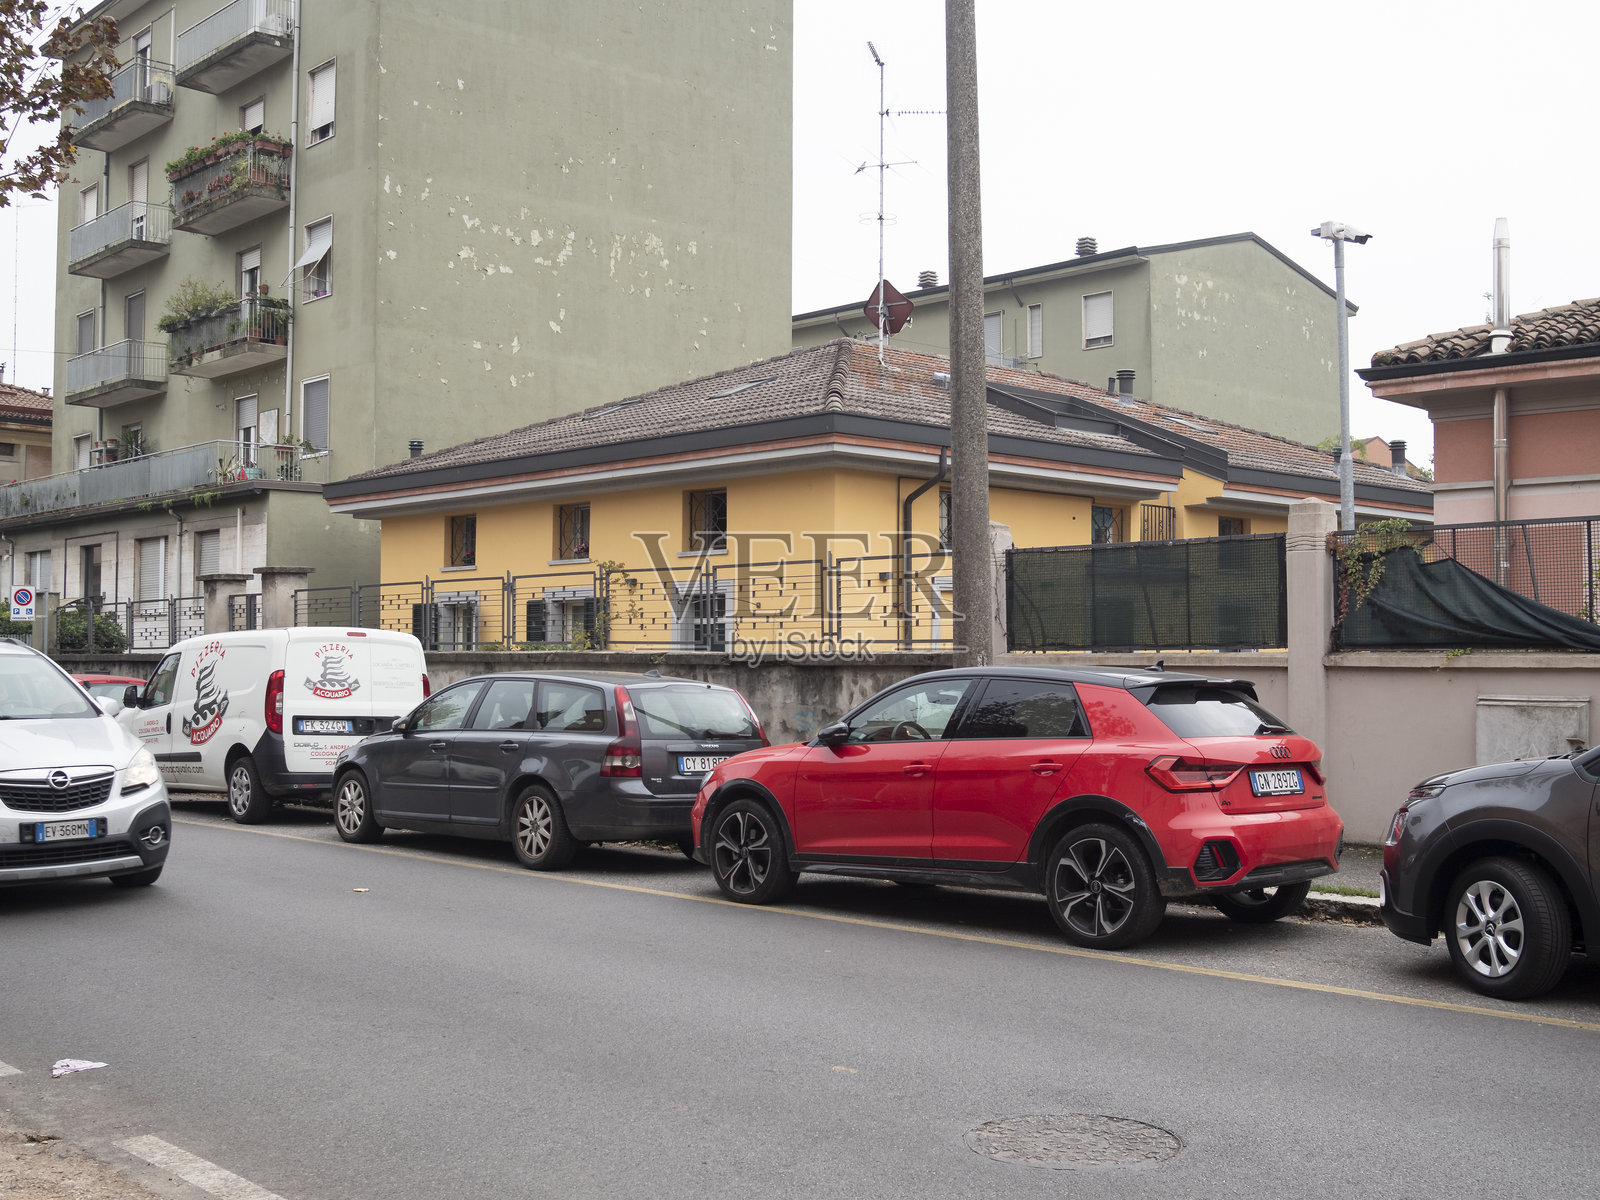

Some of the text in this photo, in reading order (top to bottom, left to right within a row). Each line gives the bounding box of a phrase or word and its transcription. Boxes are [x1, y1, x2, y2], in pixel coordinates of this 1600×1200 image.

[191, 640, 226, 678] PIZZERIA
[315, 643, 354, 660] PIZZERIA
[315, 689, 350, 698] ACQUARIO
[192, 717, 220, 742] ACQUARIO
[685, 757, 697, 770] CY
[1257, 772, 1298, 790] GN 289ZG
[45, 823, 89, 838] EV 368MN
